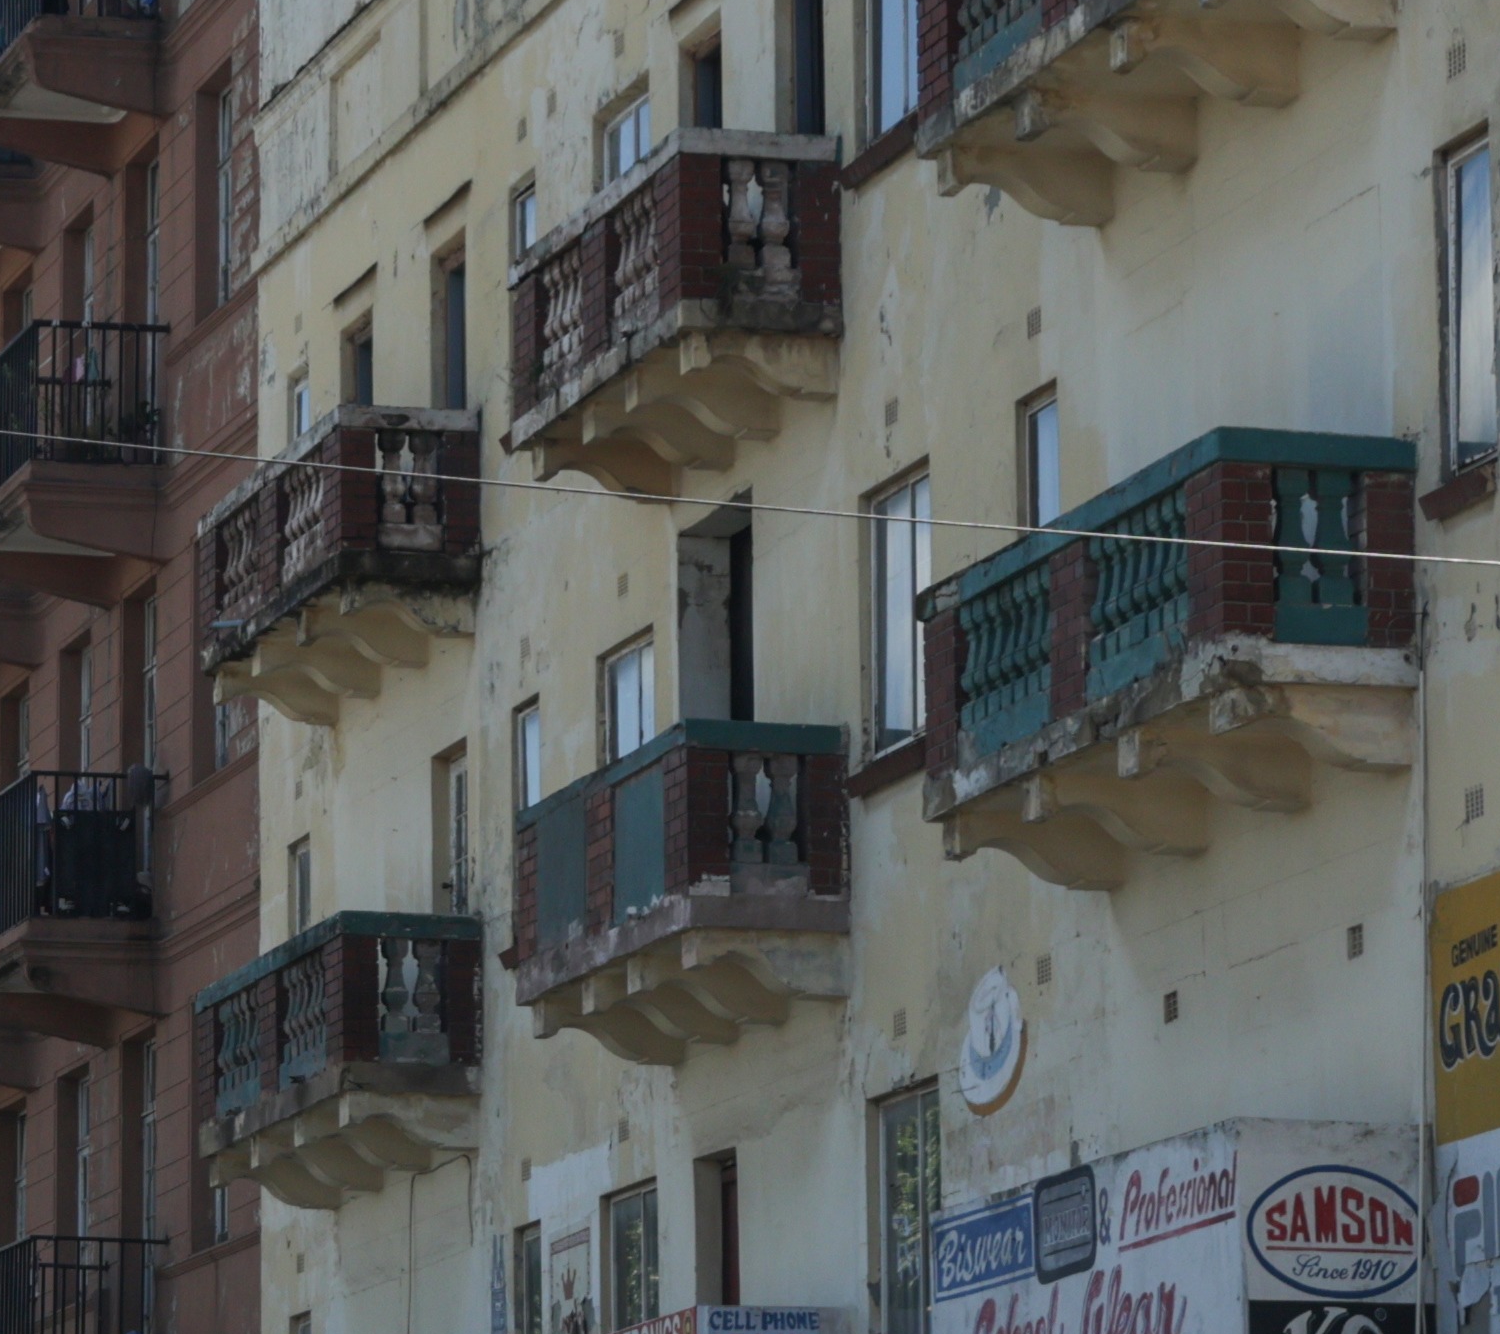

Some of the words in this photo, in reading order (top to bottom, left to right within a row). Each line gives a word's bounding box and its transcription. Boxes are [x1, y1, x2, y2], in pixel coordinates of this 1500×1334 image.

[1451, 924, 1498, 967] GENUINE
[1119, 1150, 1238, 1241] Professional
[1265, 1184, 1414, 1246] SAMSON
[935, 1225, 1027, 1288] Biswear
[1292, 1253, 1349, 1280] Since
[1350, 1256, 1397, 1281] 1910
